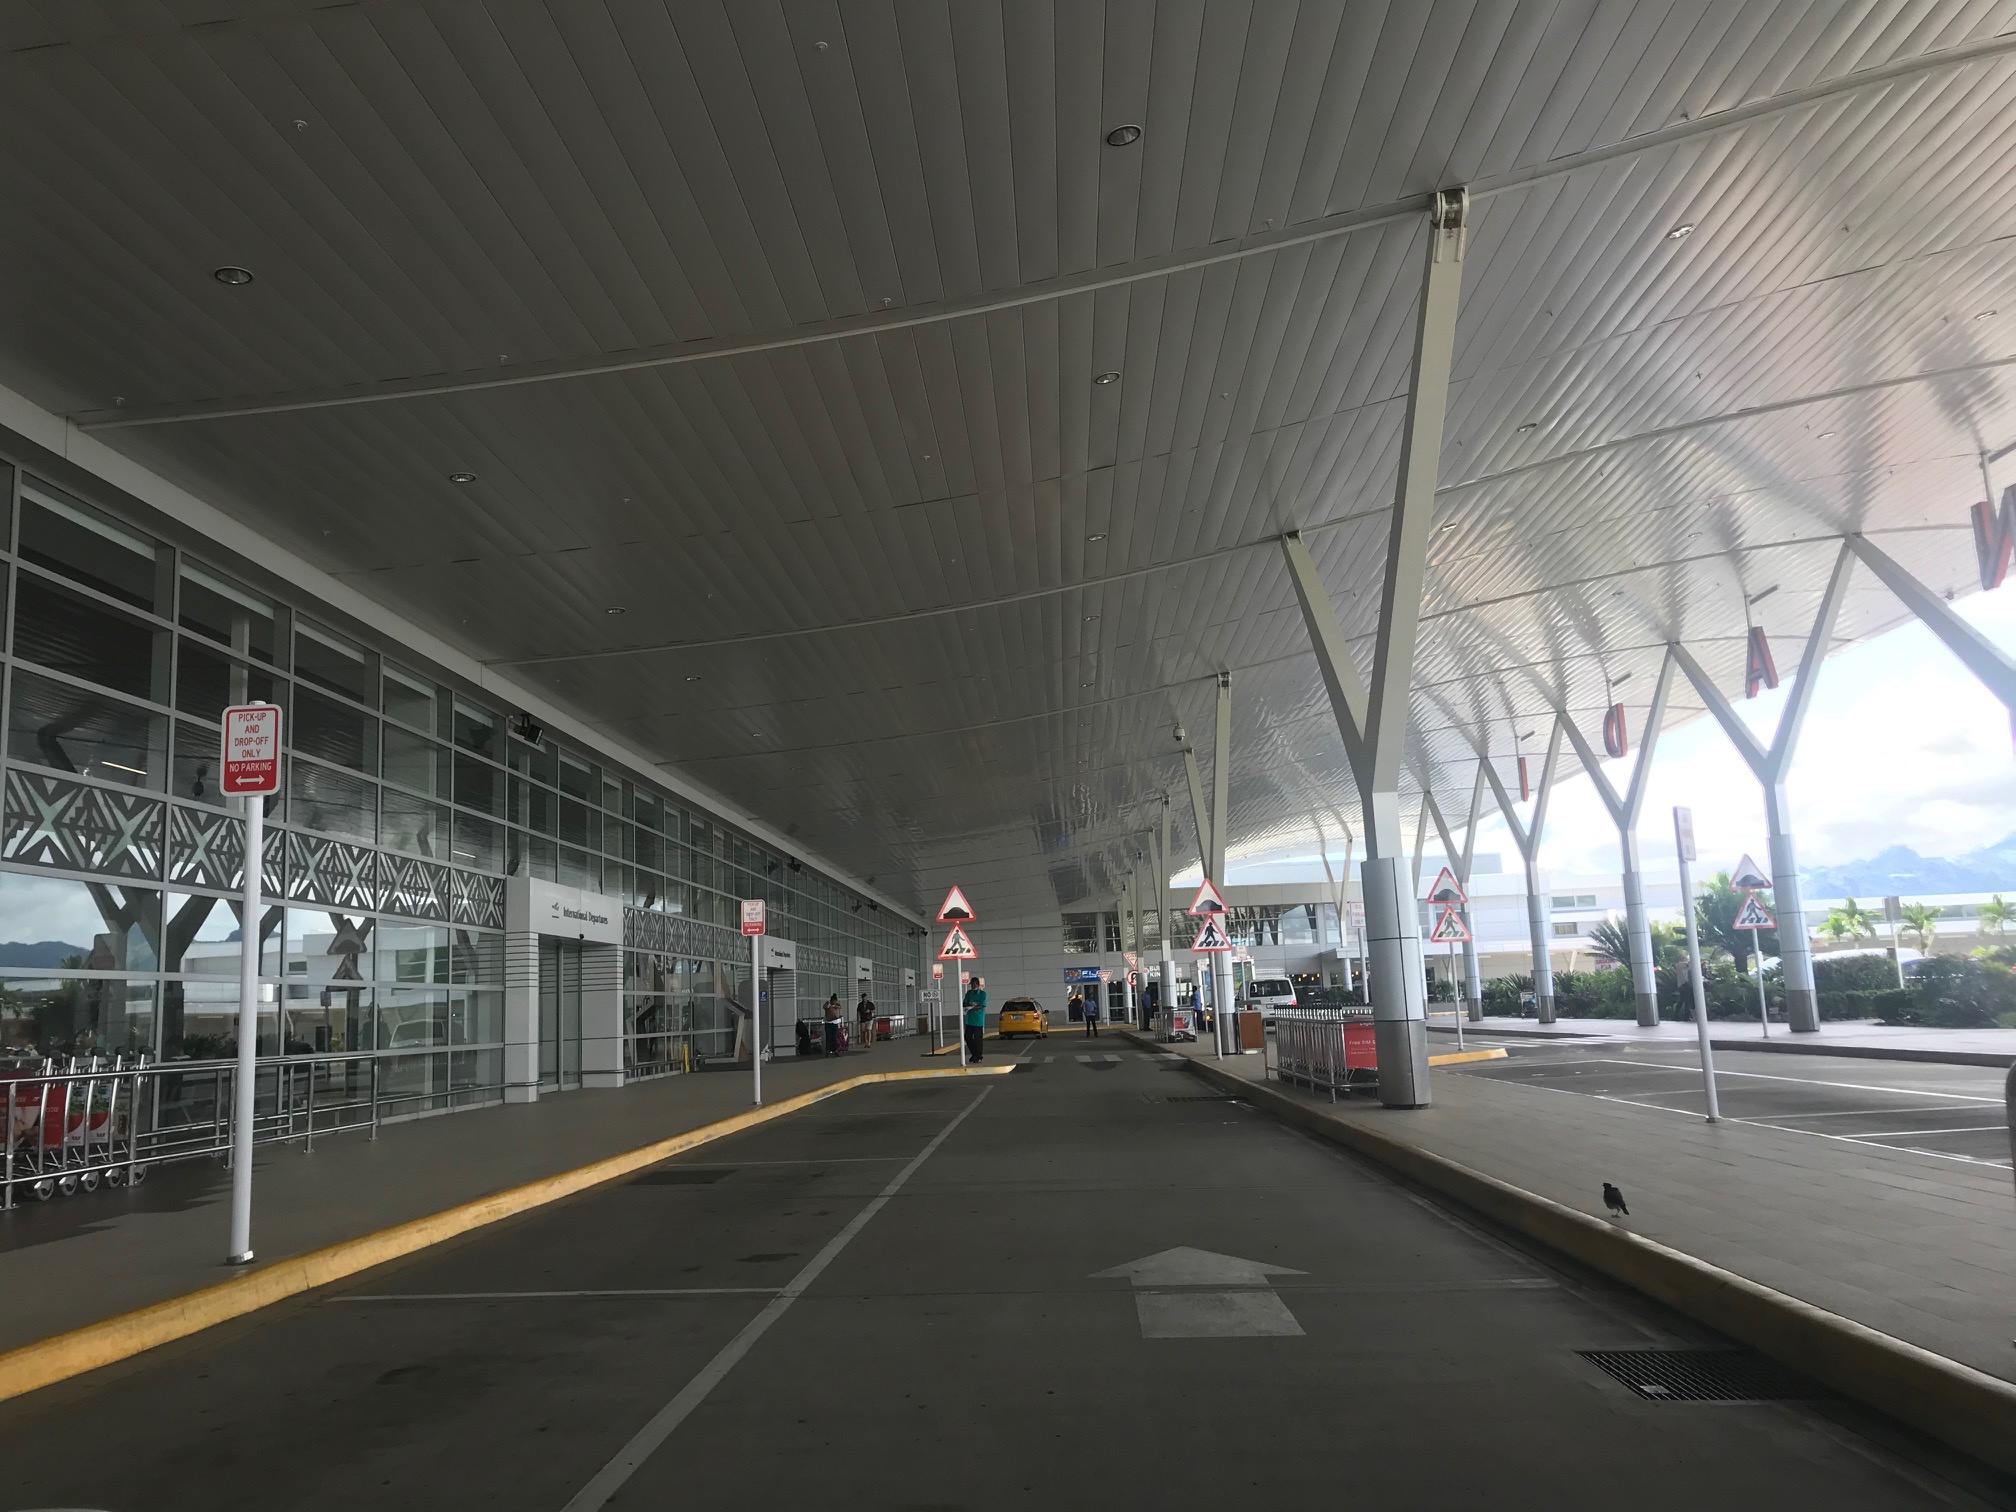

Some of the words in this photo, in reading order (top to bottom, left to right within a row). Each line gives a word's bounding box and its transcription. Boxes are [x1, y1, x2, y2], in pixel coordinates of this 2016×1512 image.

[239, 712, 267, 722] PICK-UP
[245, 725, 260, 734] AND
[234, 736, 269, 747] DROP-OFF
[241, 749, 261, 758] ONLY
[229, 763, 239, 773] NO
[240, 762, 272, 772] PARKING
[563, 906, 588, 921] International
[588, 912, 608, 925] Departures
